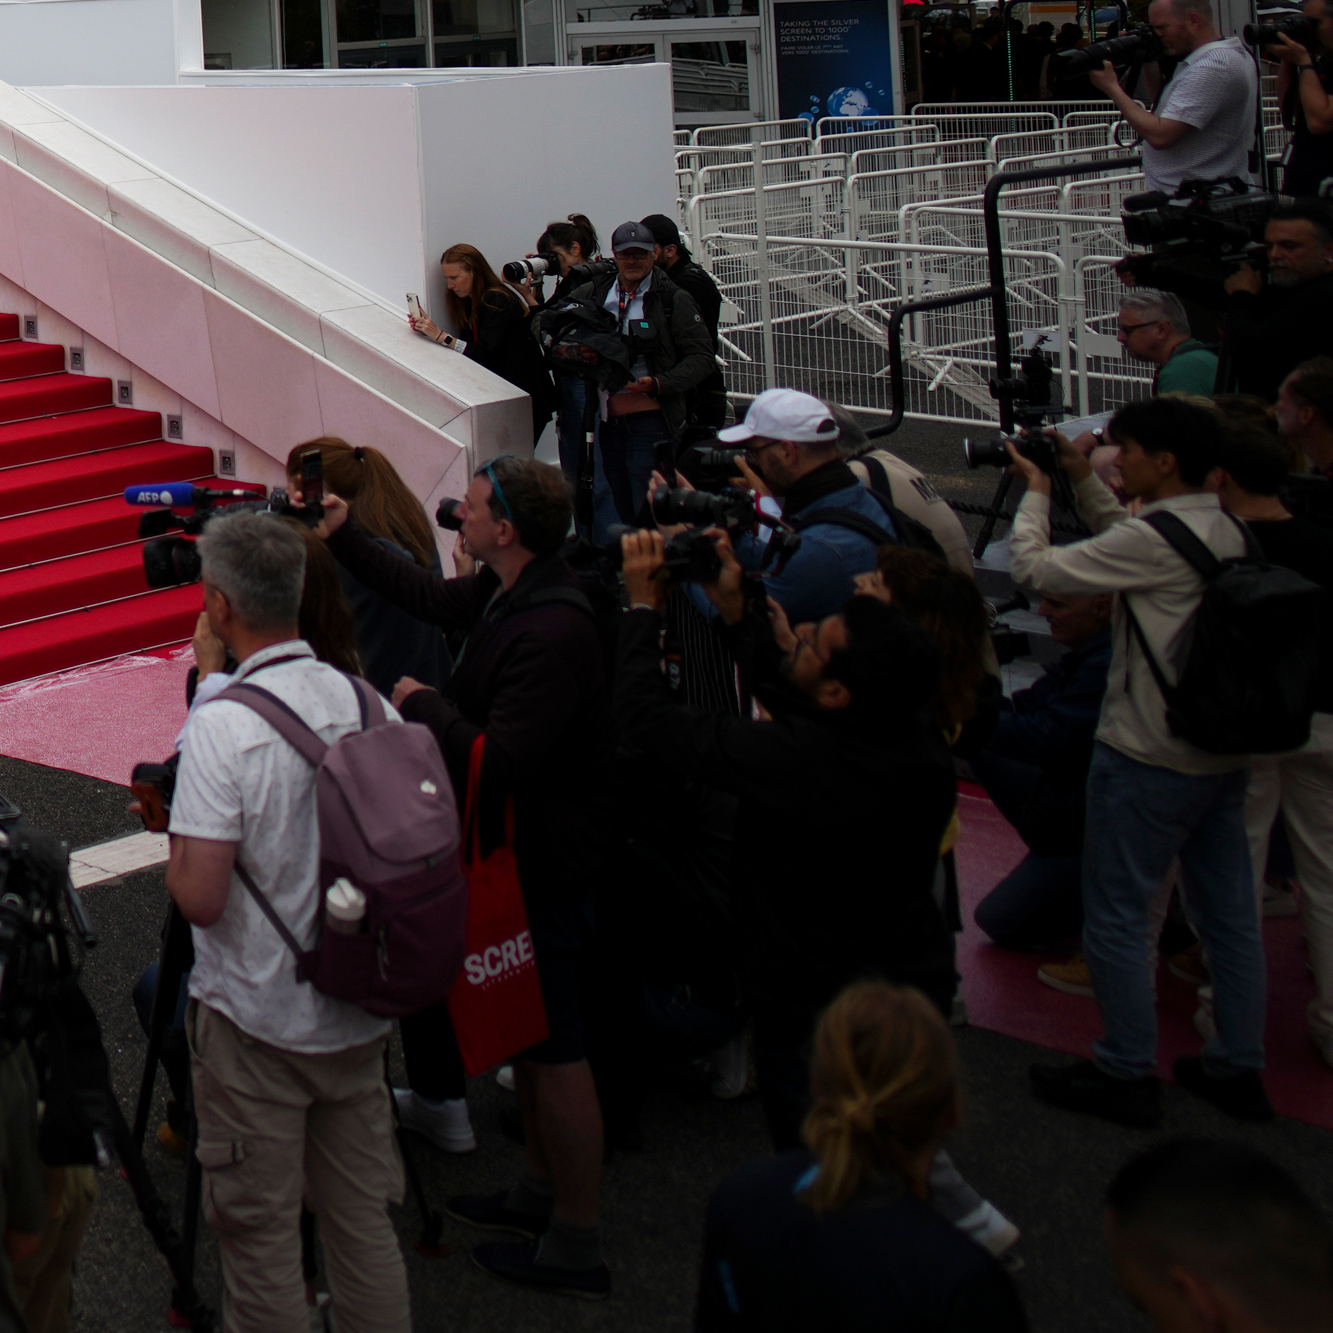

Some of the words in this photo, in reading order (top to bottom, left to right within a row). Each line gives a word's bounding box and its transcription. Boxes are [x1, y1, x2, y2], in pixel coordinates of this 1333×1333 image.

[831, 18, 859, 26] SILVER
[780, 27, 812, 35] SCREEN
[780, 33, 843, 43] DESTINATIONS.
[137, 490, 159, 503] AFP
[464, 929, 535, 985] SCRE
